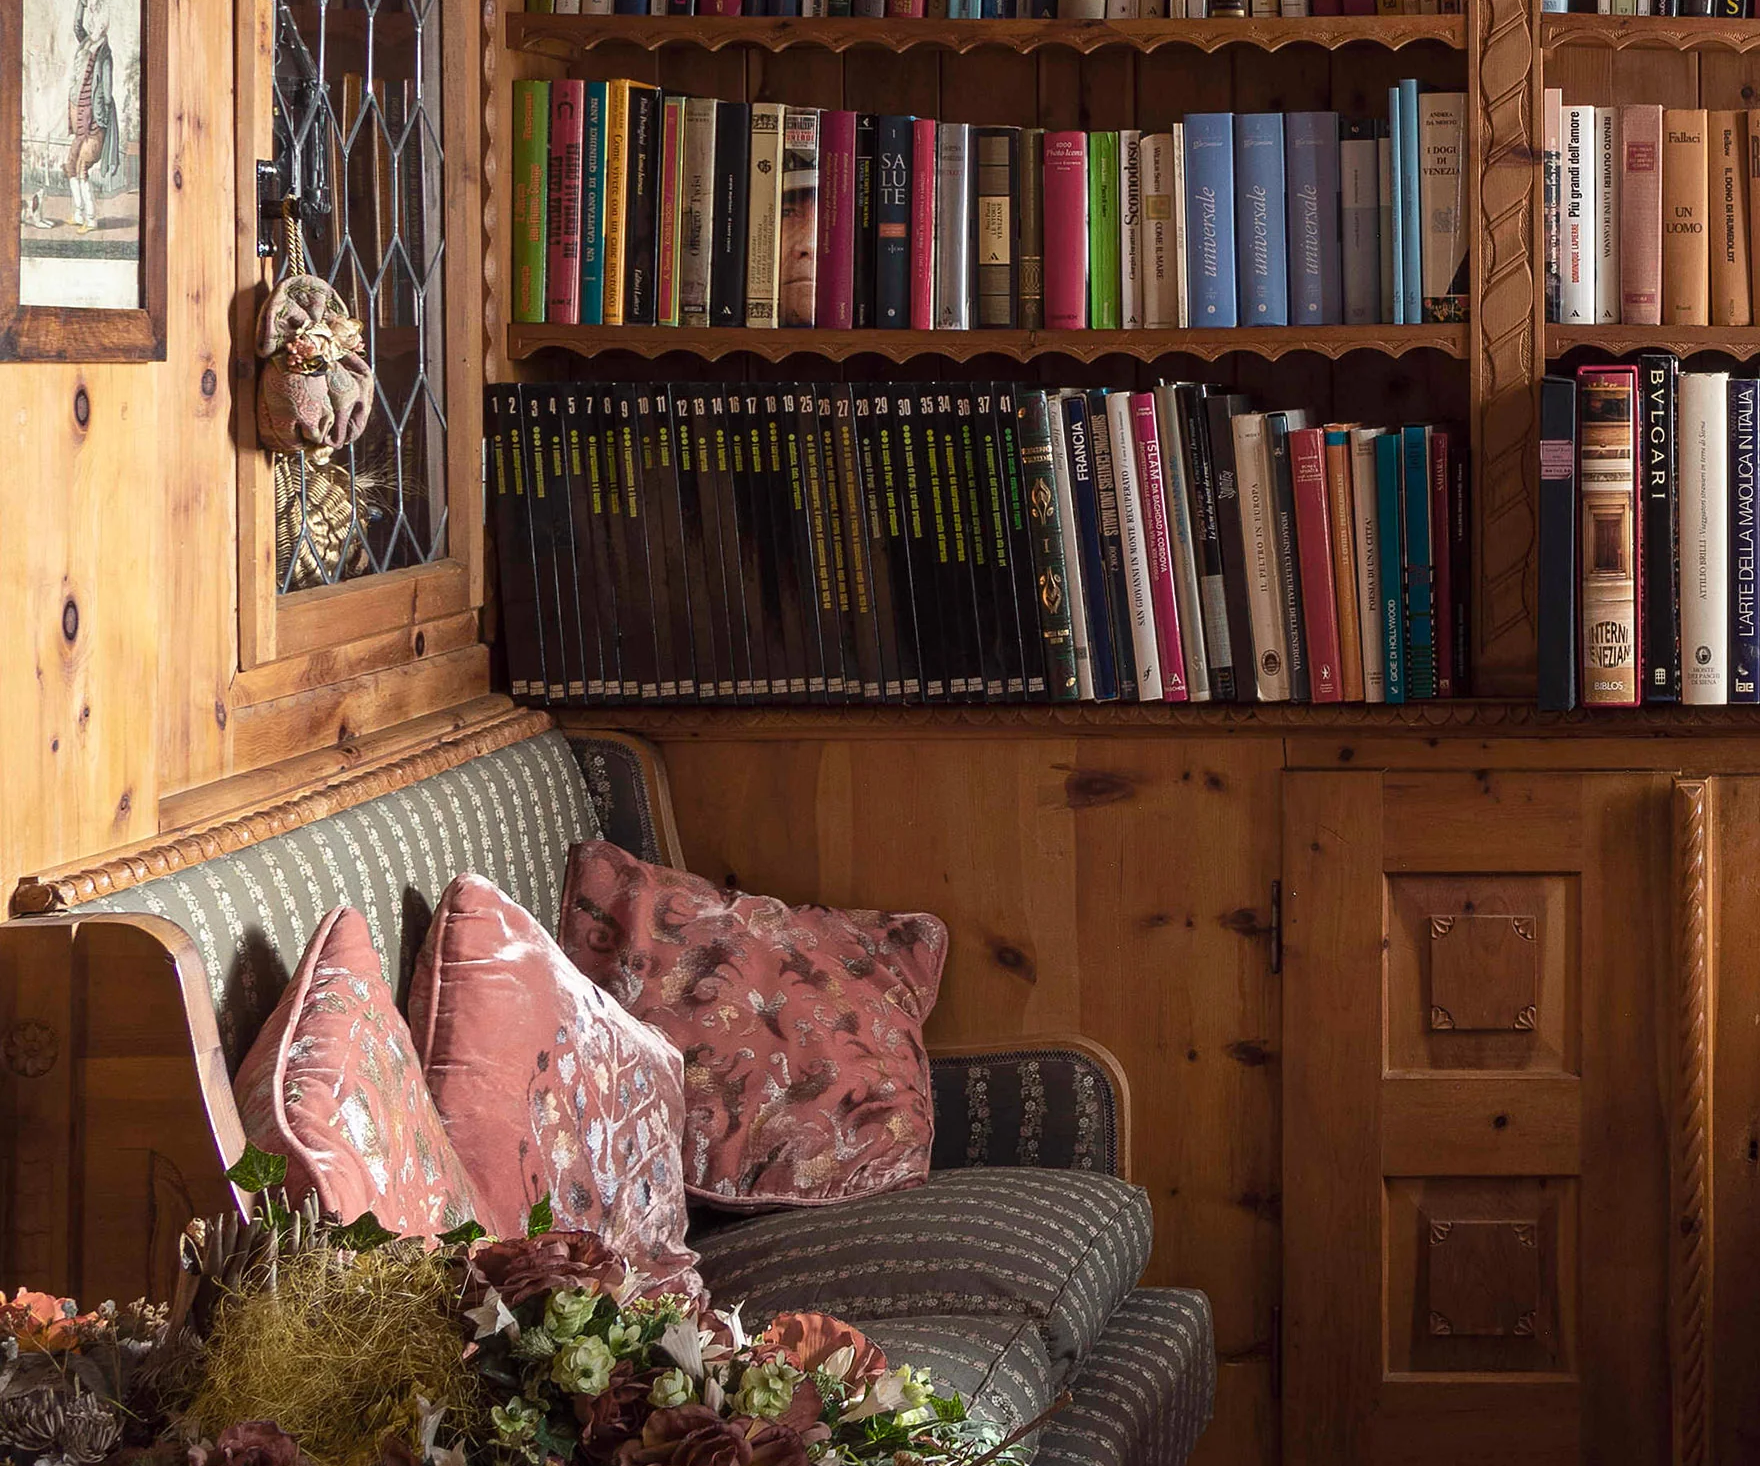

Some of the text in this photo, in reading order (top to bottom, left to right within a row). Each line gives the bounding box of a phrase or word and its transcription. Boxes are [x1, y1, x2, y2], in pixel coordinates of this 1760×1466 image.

[1668, 132, 1701, 144] Fallaci
[1433, 146, 1457, 154] DOGI
[1436, 157, 1447, 165] DI
[586, 97, 600, 262] UN CAPITANO DI QUINDICI ANNI
[1423, 167, 1460, 176] VENEZIA
[1123, 141, 1141, 226] Scomodoso
[1568, 112, 1582, 283] DOMINIQUE LAPIERRE Più grandi dell'amore
[1722, 129, 1738, 263] Bellow IL DONO DI HUMBOLDT
[607, 134, 623, 307] Come vivere con un cane nevrotico
[1675, 206, 1692, 218] UN
[1195, 186, 1217, 277] universale
[1245, 185, 1268, 276] universale
[1296, 184, 1318, 275] universale
[1666, 222, 1703, 234] UOMO
[491, 397, 498, 413] 1
[509, 398, 517, 414] 2
[530, 400, 538, 418] 3
[549, 398, 556, 414] 4
[568, 398, 575, 414] 5
[586, 397, 593, 414] 7
[604, 398, 611, 414] 8
[621, 400, 628, 418] 9
[638, 398, 649, 414] 10
[656, 395, 667, 413] 11
[677, 400, 688, 417] 12
[693, 398, 704, 416] 13
[712, 398, 724, 414] 14
[729, 396, 740, 414] 16
[746, 397, 757, 414] 17
[765, 397, 776, 413] 18
[783, 395, 794, 413] 19
[800, 395, 813, 413] 25
[819, 399, 830, 416] 26
[837, 400, 849, 418] 27
[856, 399, 869, 416] 28
[876, 396, 888, 414] 29
[898, 399, 911, 416] 30
[921, 397, 934, 414] 35
[938, 395, 951, 414] 34
[958, 399, 970, 416] 36
[978, 396, 990, 414] 37
[1000, 396, 1012, 414] 41
[1649, 370, 1667, 499] BVLGARI
[1072, 421, 1090, 482] FRANCIA
[1146, 440, 1161, 480] ISLAM
[1091, 415, 1119, 536] SHOPPING CENTERS AND MALLS
[1738, 389, 1755, 636] L'ARTE DELLA MAIOLICA IN ITALIA
[1594, 681, 1624, 691] BIBLOS
